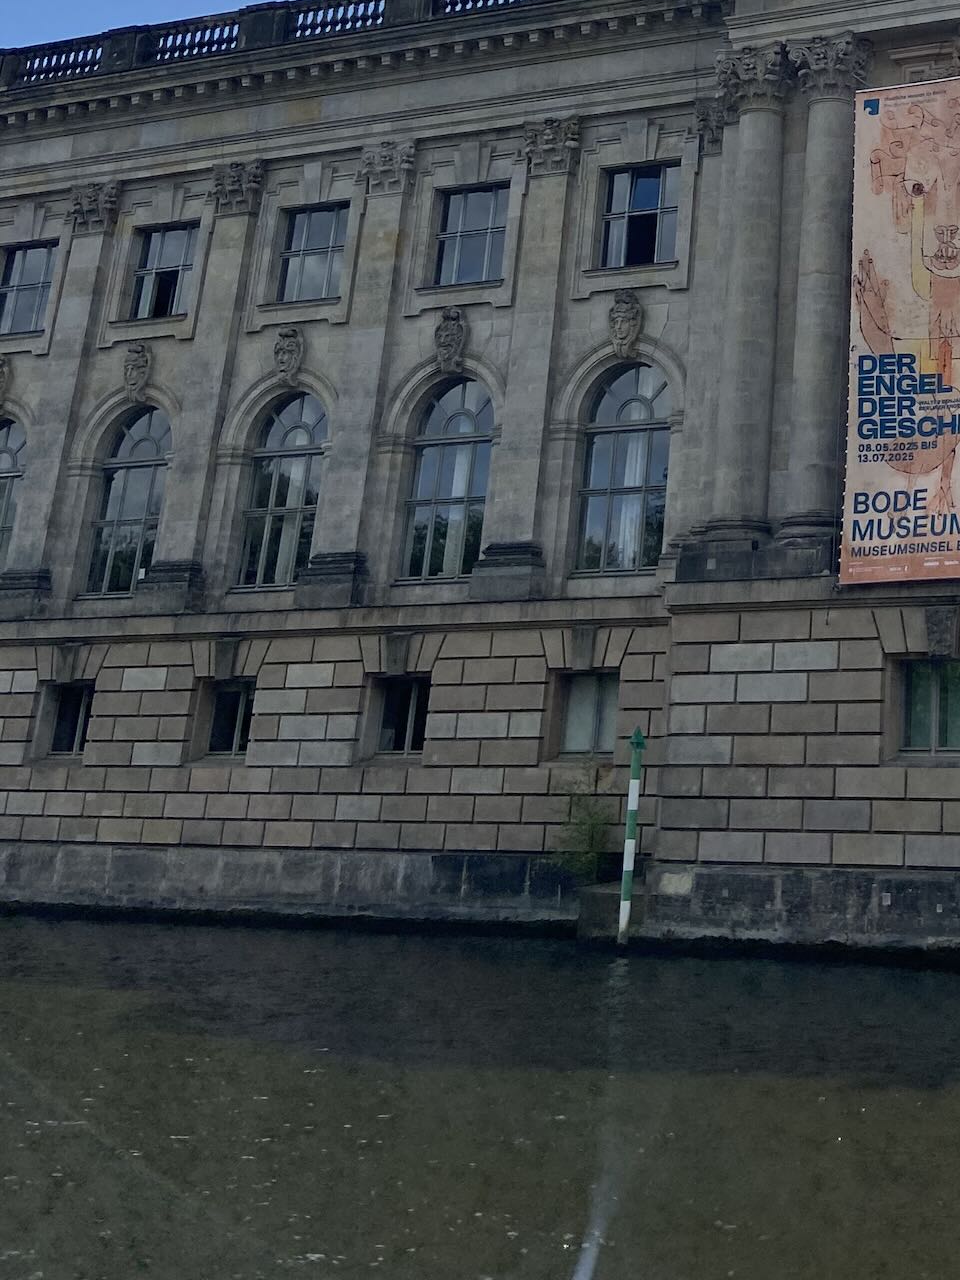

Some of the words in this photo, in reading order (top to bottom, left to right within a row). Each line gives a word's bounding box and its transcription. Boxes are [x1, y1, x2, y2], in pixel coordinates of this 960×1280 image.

[858, 353, 916, 375] DER
[857, 373, 953, 396] ENGEL
[858, 396, 916, 418] DER
[858, 441, 919, 453] 08.05.2025
[921, 440, 938, 450] BIS
[858, 452, 914, 463] 13.07.2025
[853, 488, 928, 515] BODE
[851, 540, 953, 558] MUSEUMSINSEL
